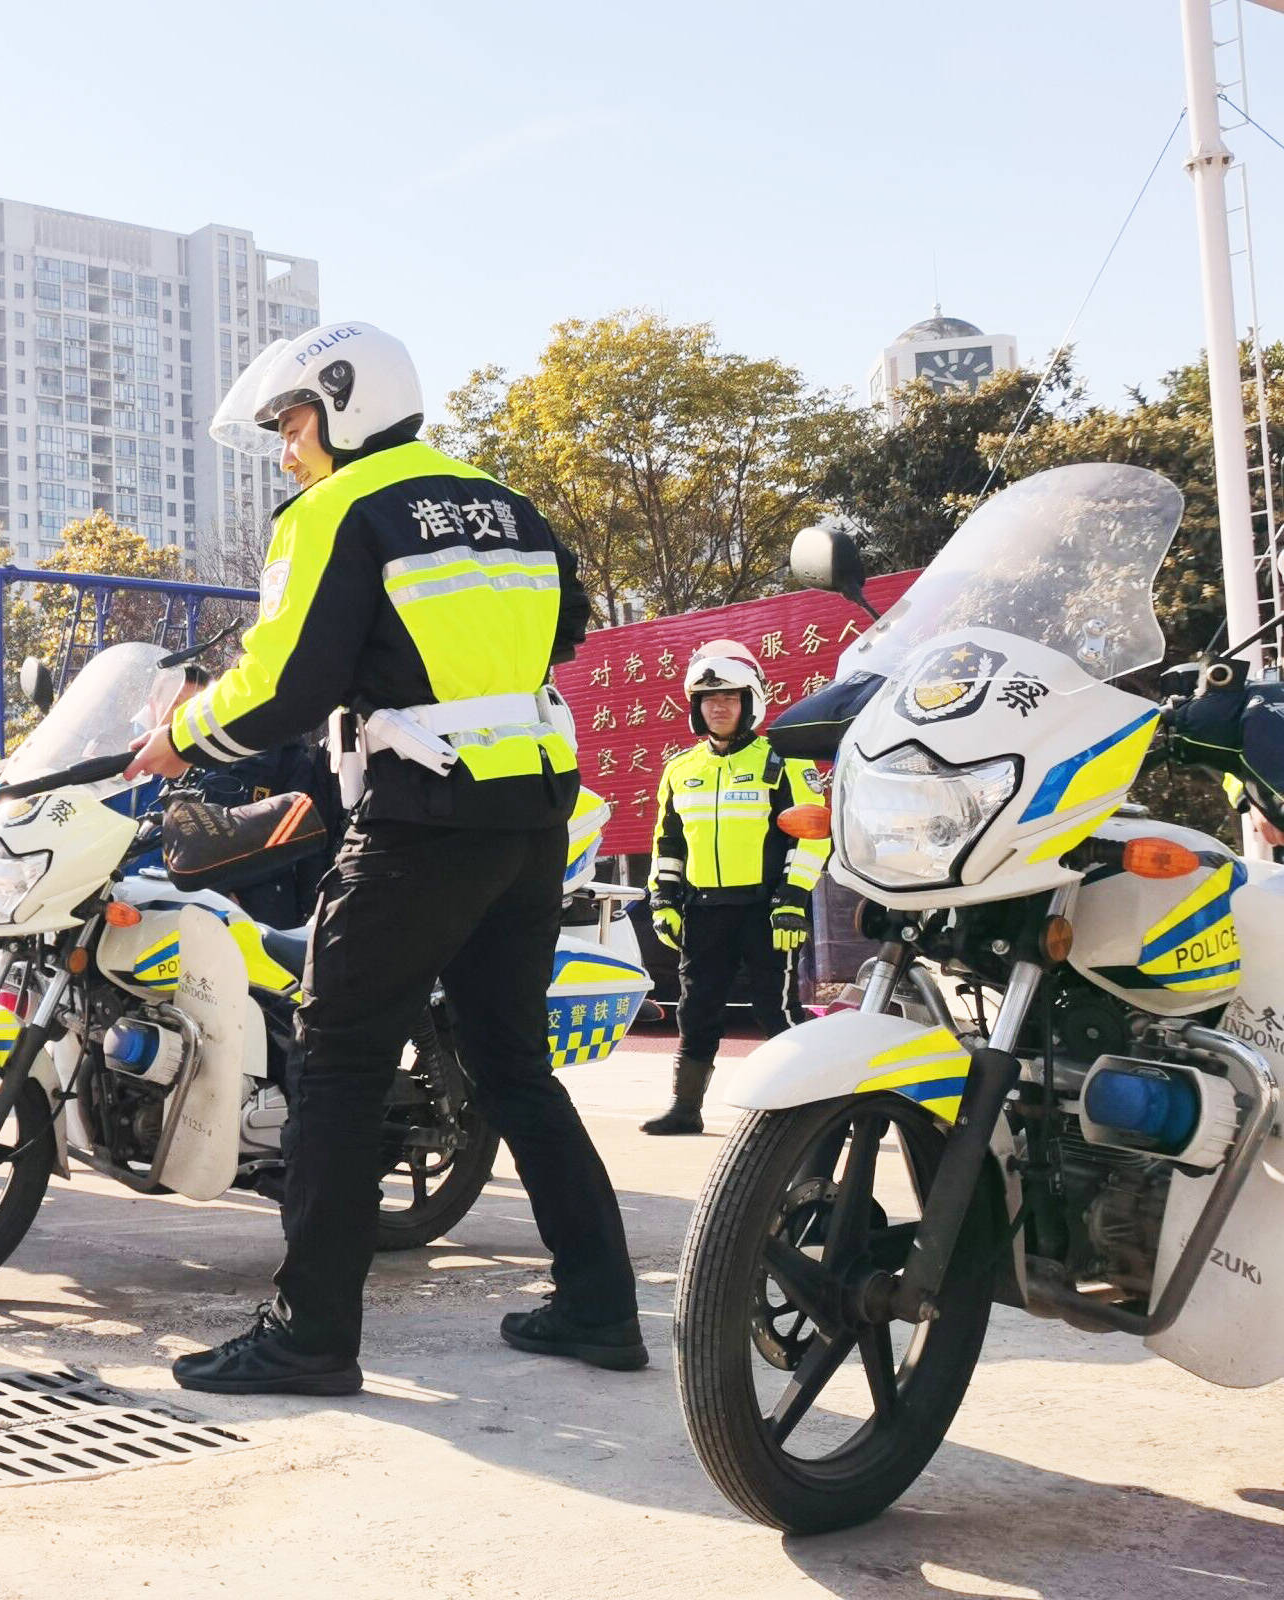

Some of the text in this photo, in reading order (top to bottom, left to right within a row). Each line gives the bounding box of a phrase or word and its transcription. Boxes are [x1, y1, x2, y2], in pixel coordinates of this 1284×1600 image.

[295, 326, 363, 366] POLICE
[997, 671, 1049, 718] 察
[47, 800, 76, 827] 察
[1175, 926, 1238, 969] POLICE
[158, 960, 180, 977] PO
[548, 996, 631, 1029] 交警铁骑
